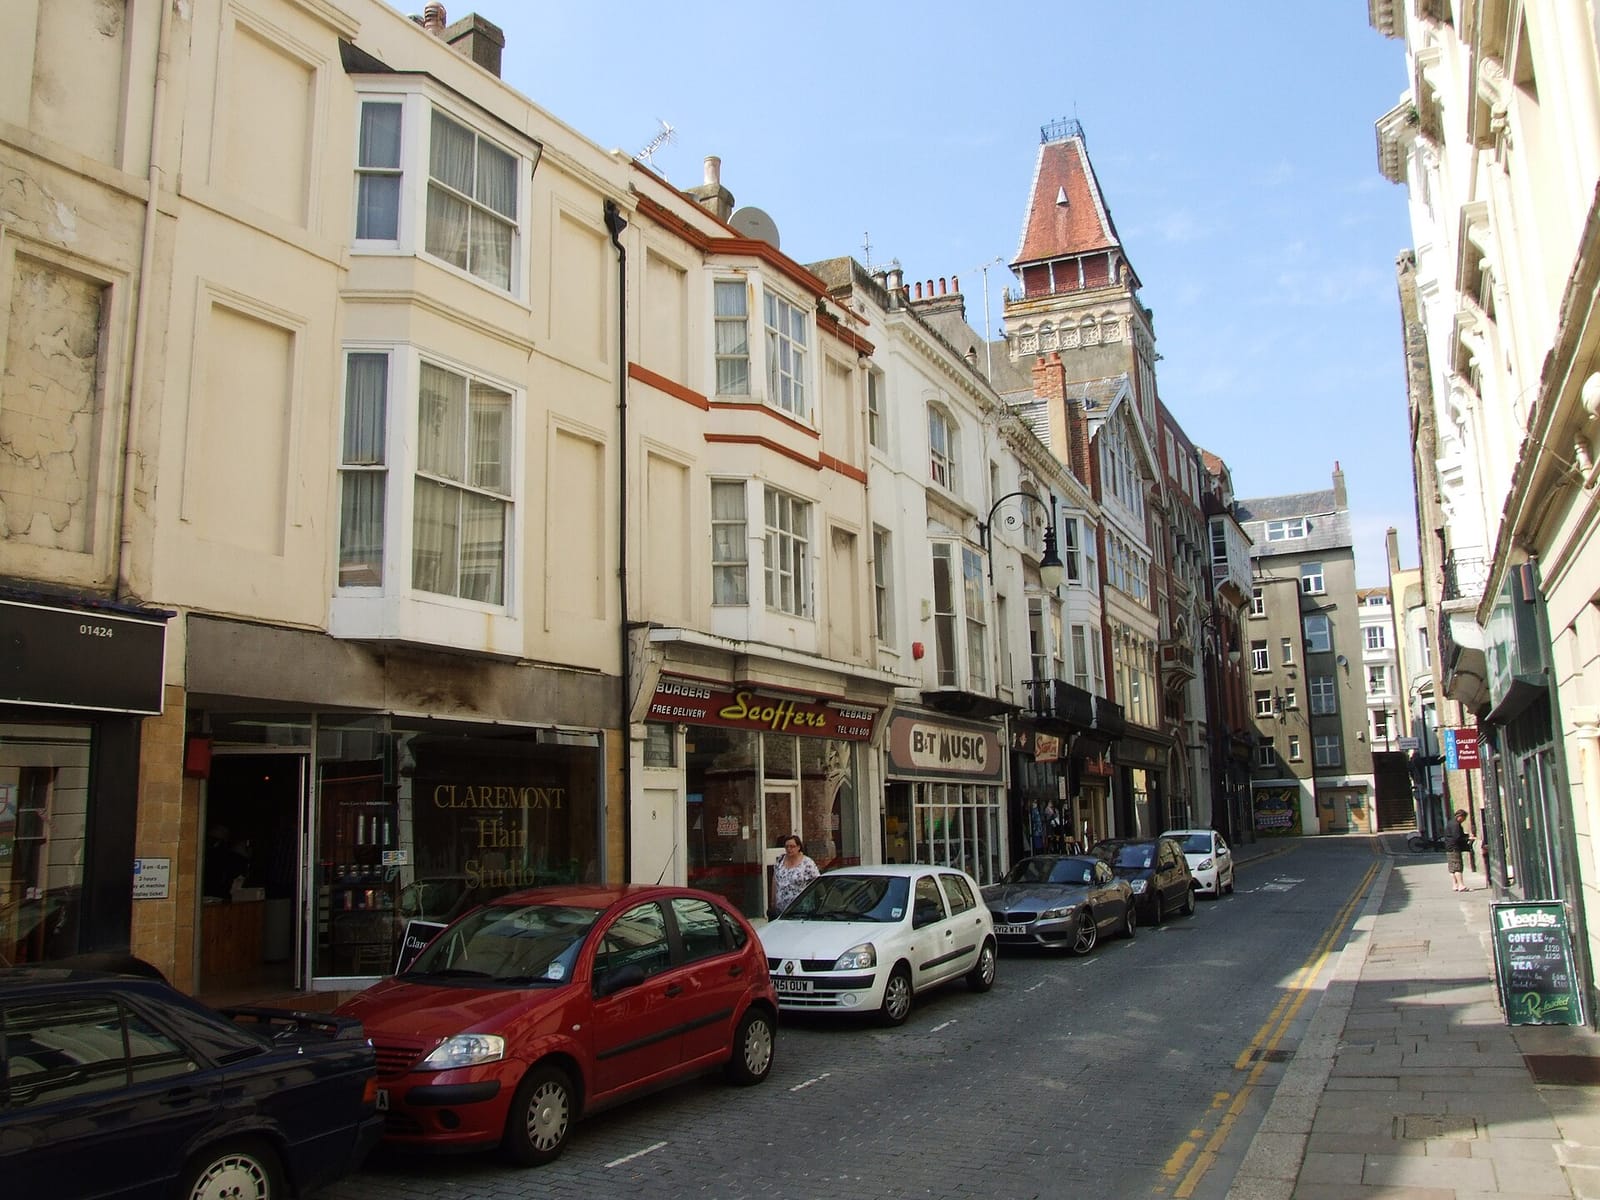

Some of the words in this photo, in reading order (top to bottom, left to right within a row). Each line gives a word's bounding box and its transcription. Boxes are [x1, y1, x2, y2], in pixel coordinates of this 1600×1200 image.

[80, 624, 113, 638] 01424
[656, 683, 711, 699] BURGERS
[652, 704, 671, 715] FREE
[673, 707, 706, 718] DELIVERY
[719, 691, 826, 731] Scoffers
[839, 709, 873, 721] KEBABS
[837, 725, 848, 734] TEL
[939, 732, 985, 765] MUSIC
[434, 784, 565, 809] CLAREMONT
[477, 818, 528, 849] Hair
[465, 858, 535, 890] Studio
[1508, 933, 1543, 943] COFFEE
[1511, 962, 1533, 970] TEA
